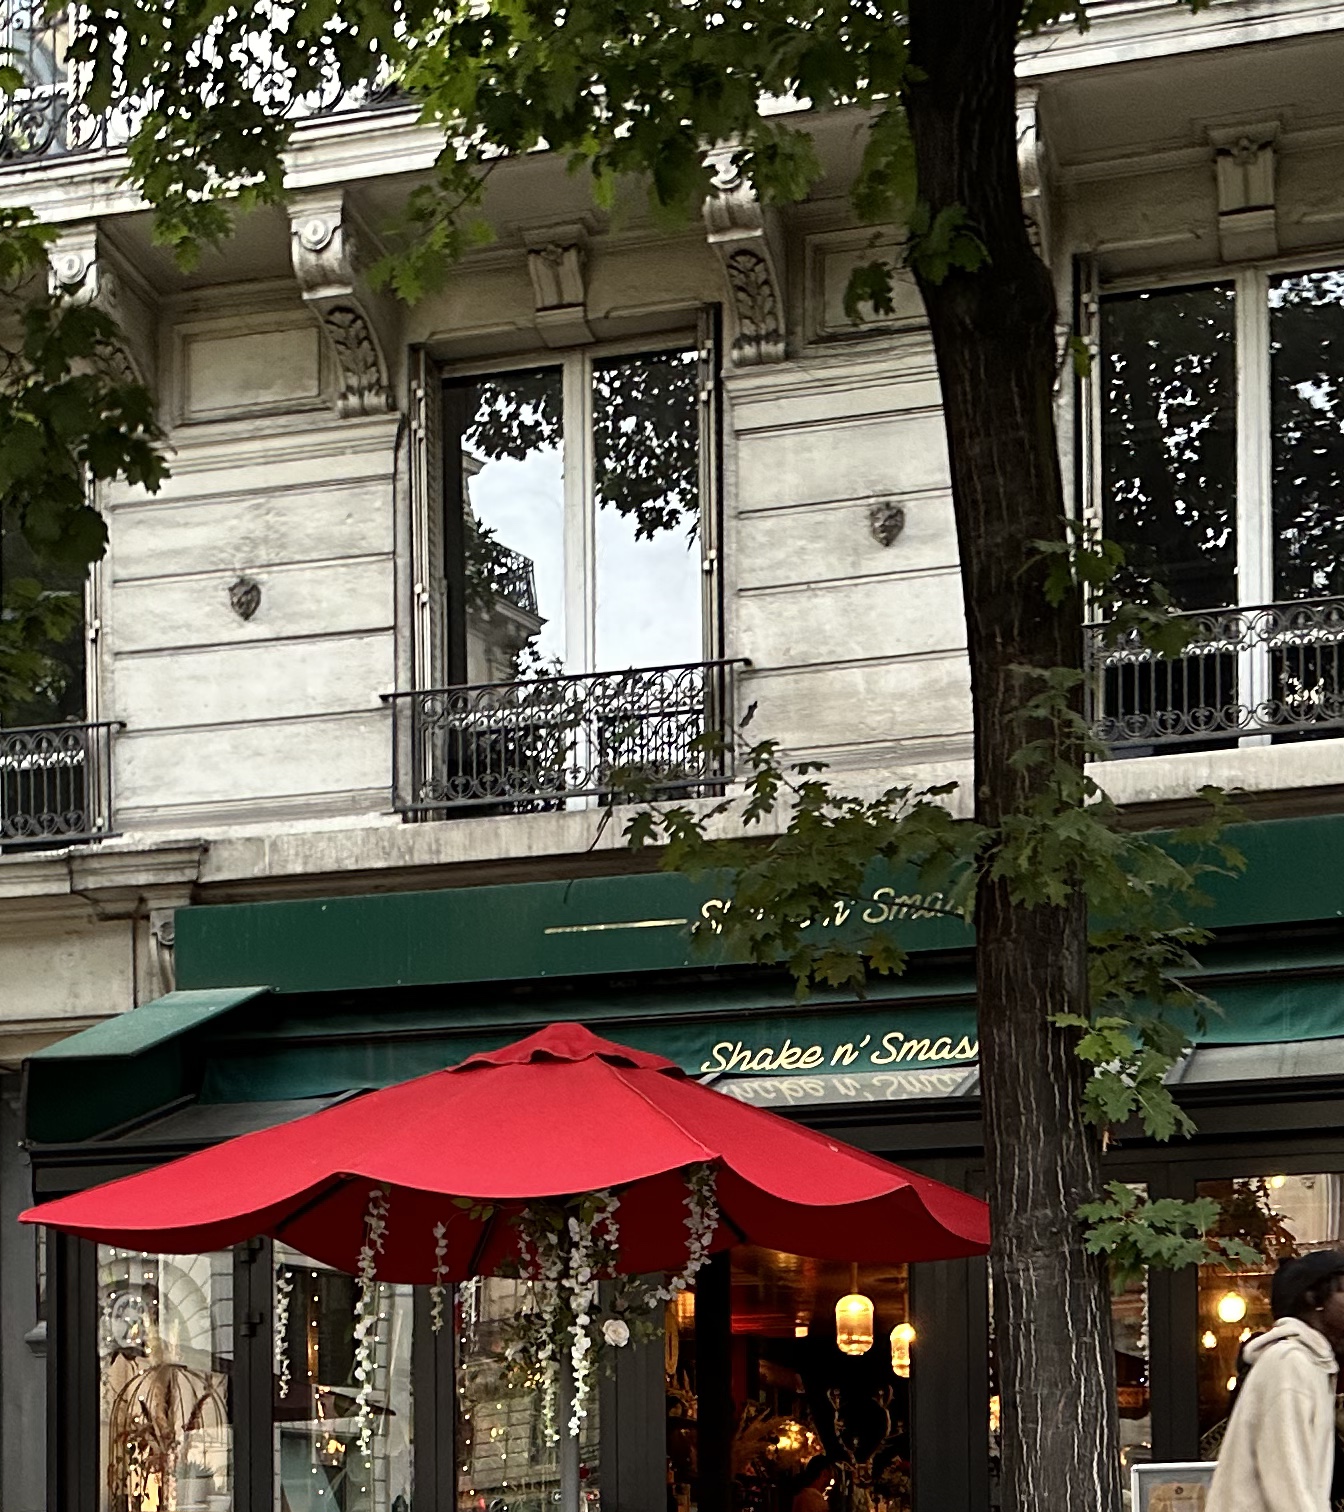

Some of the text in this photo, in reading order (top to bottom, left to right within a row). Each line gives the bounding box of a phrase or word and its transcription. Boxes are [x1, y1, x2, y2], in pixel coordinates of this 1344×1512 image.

[701, 1032, 979, 1073] Shake n' Smas
